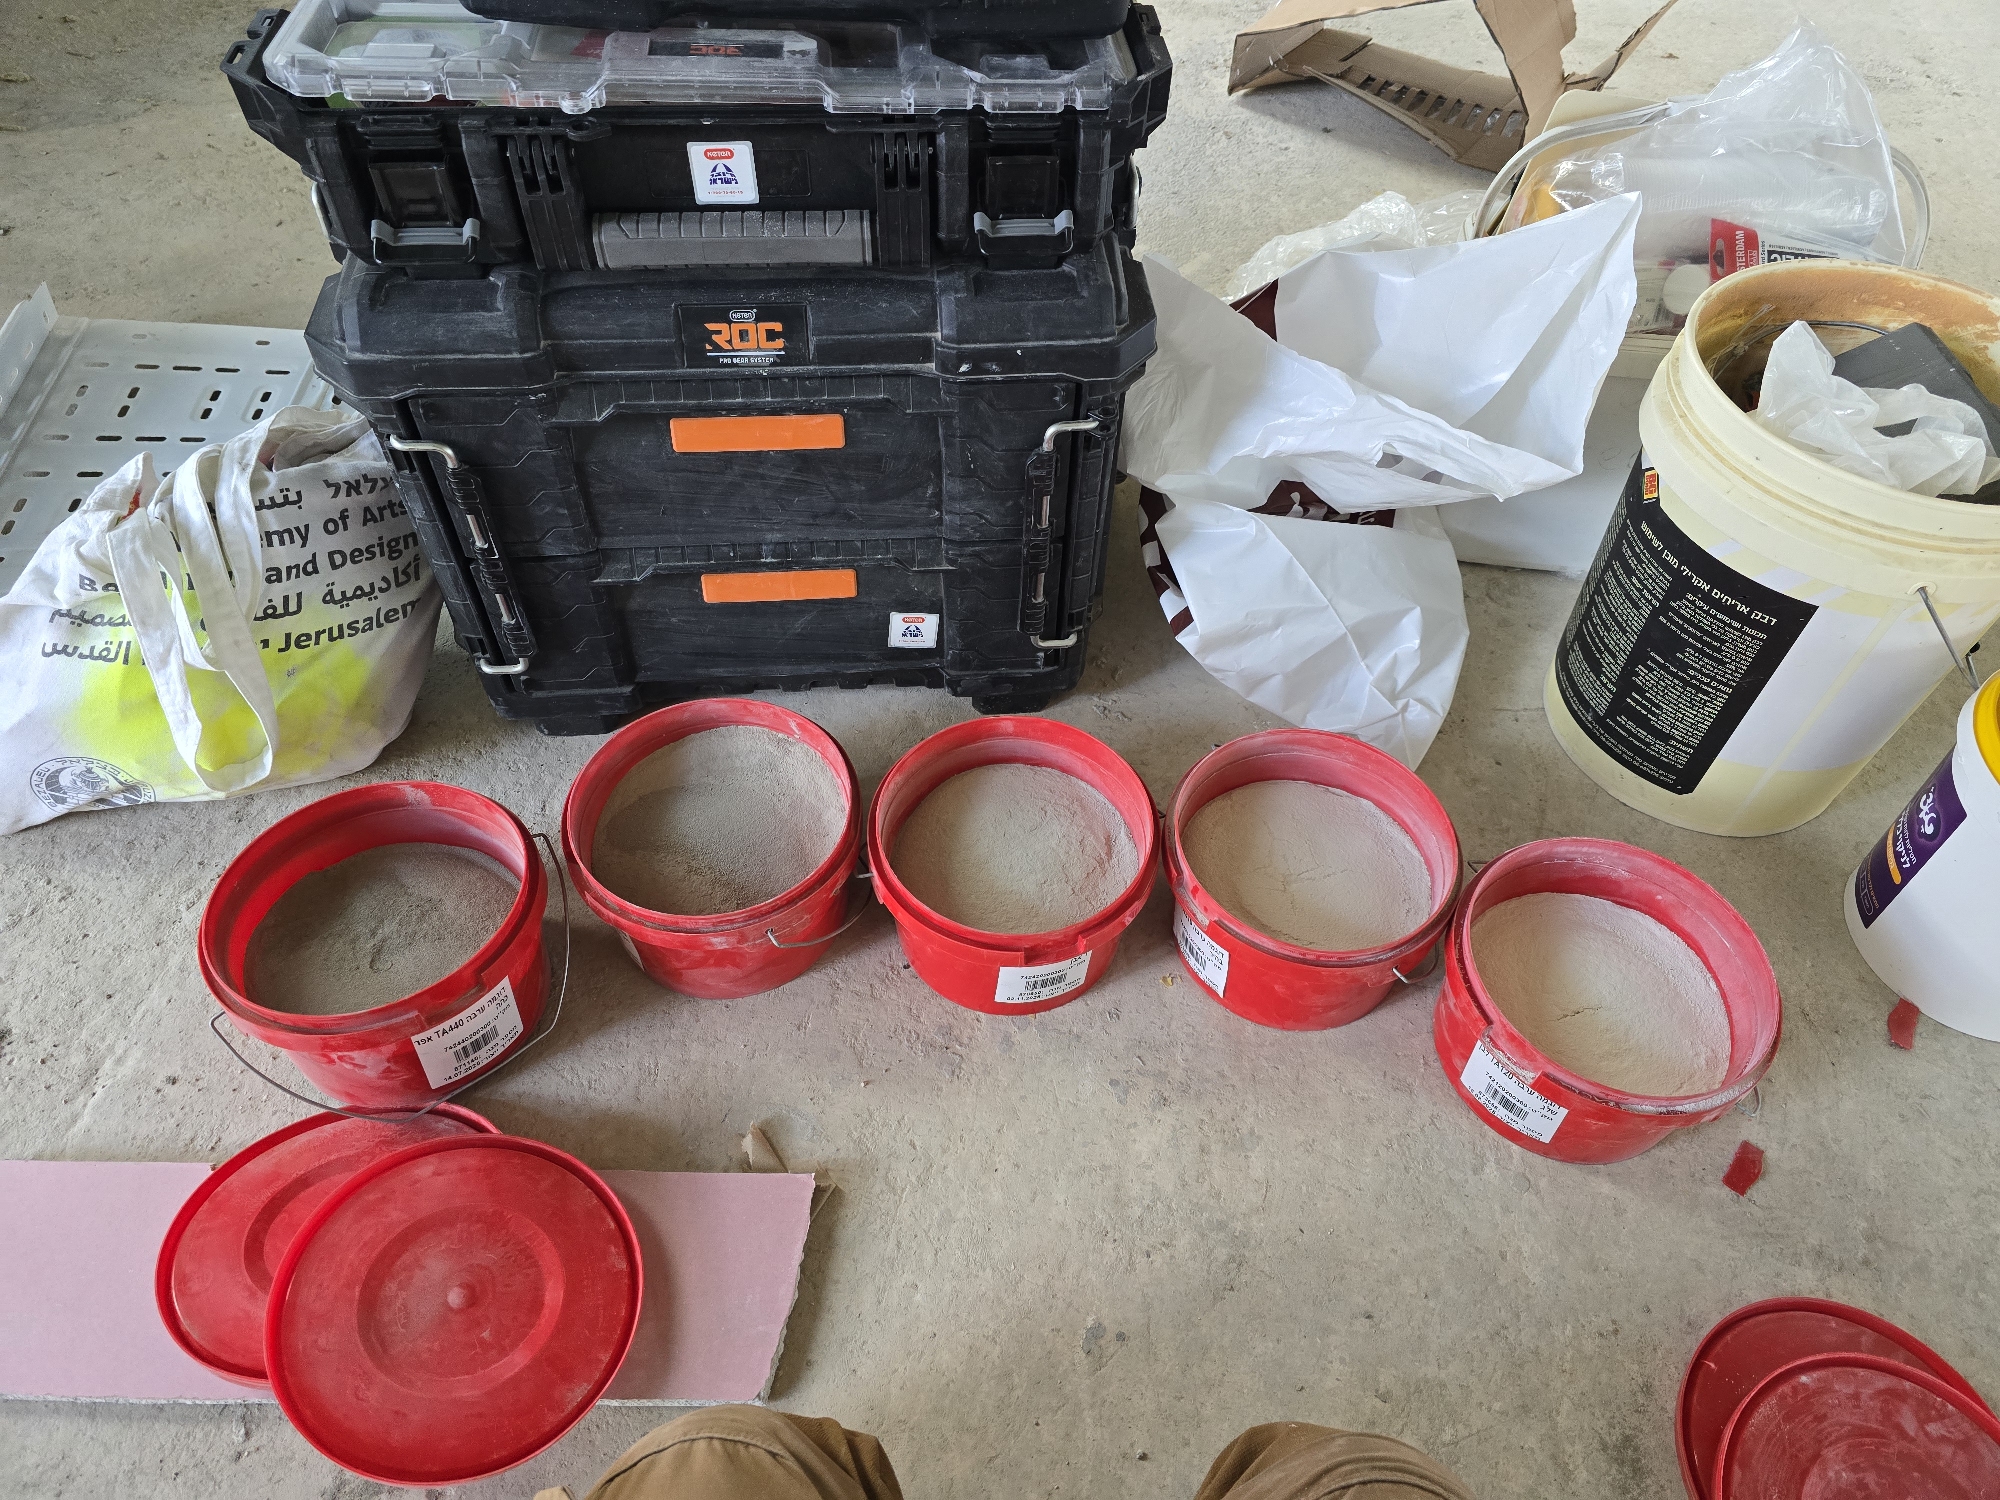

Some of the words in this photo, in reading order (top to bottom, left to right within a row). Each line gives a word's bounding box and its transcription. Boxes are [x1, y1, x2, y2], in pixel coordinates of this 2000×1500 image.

[1735, 230, 1745, 271] STERDAM
[703, 321, 785, 350] ROC
[323, 508, 350, 536] of
[362, 499, 408, 527] Arts
[264, 552, 320, 584] and
[327, 531, 419, 571] Design
[1662, 549, 1679, 568] מוכן
[1680, 565, 1711, 592] אקרילי
[1712, 588, 1749, 614] אריחים
[1751, 610, 1778, 625] דבק
[413, 1036, 434, 1046] אפר
[434, 1018, 464, 1039] TA440
